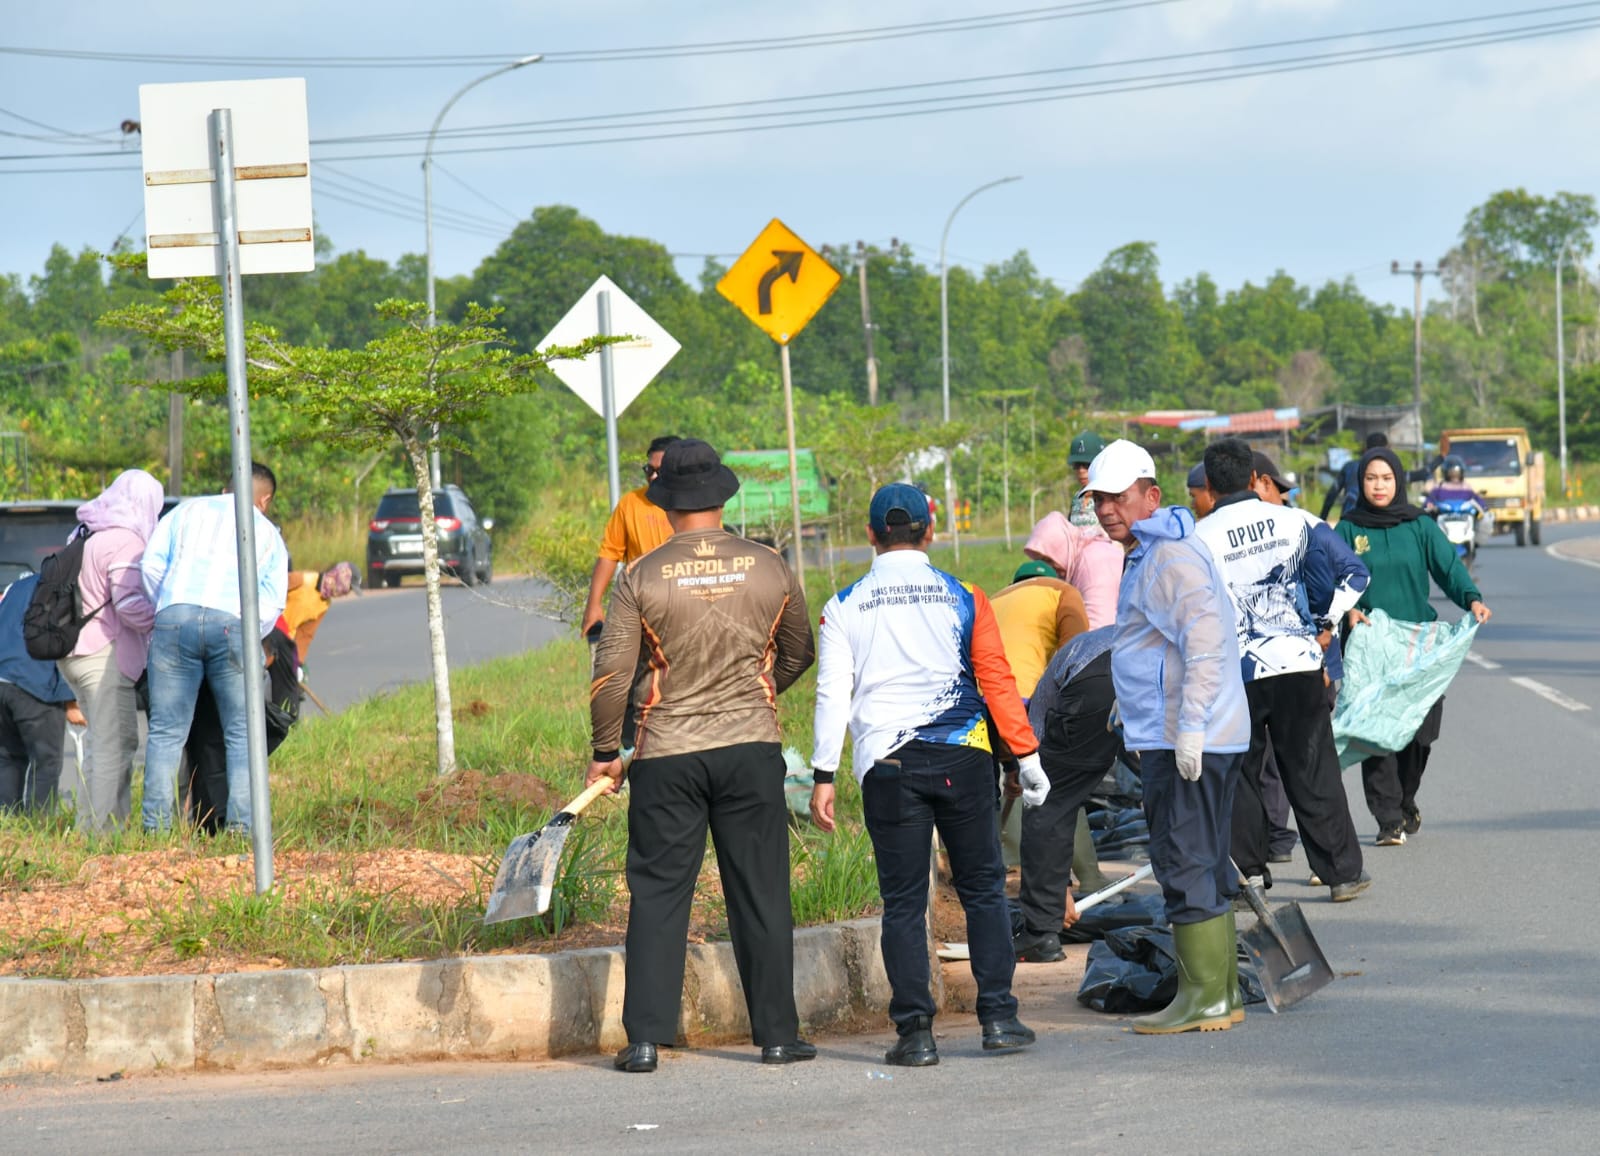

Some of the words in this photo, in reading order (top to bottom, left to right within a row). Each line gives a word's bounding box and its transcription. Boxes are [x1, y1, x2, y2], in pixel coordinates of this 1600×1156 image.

[661, 559, 726, 579] SATPOL
[732, 557, 755, 572] PP
[677, 576, 718, 587] PROVINSI
[718, 573, 745, 583] KEPRI
[871, 586, 888, 598] DINAS
[889, 584, 922, 595] PEKERJAAN
[923, 584, 943, 594] UMUM
[886, 596, 908, 606] RUANG
[908, 595, 920, 604] DAN
